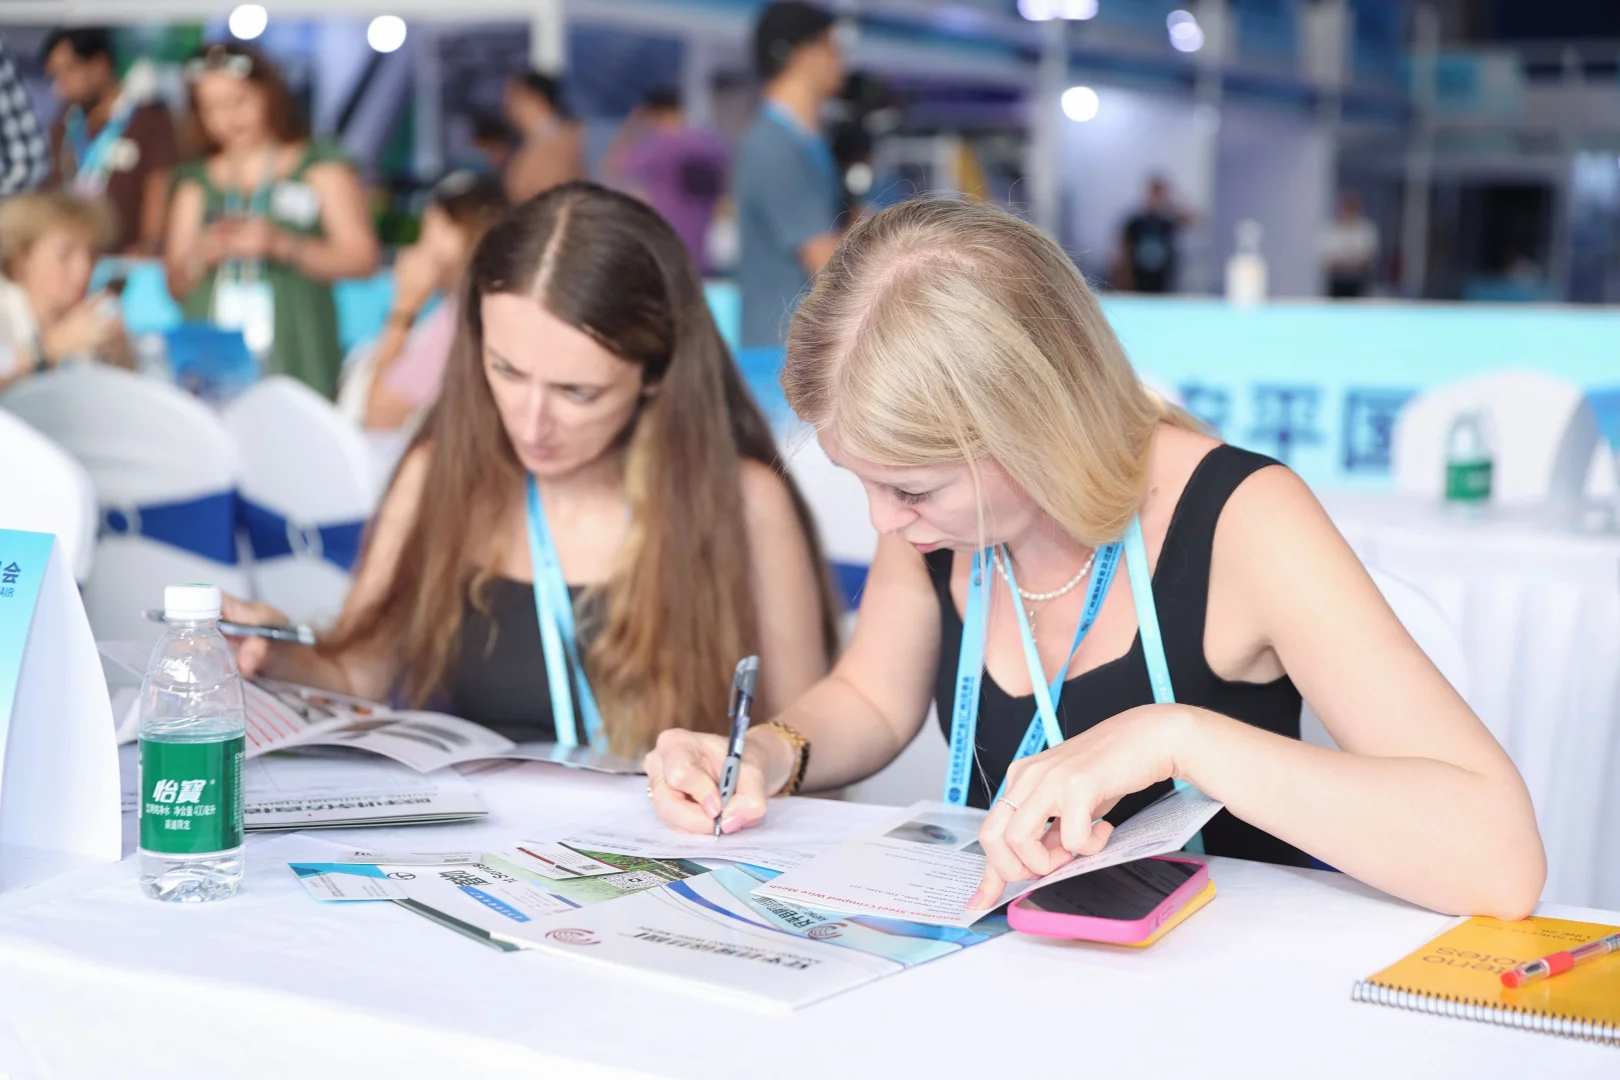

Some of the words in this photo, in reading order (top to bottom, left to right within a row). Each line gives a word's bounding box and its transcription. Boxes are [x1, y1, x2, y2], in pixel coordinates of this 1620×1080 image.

[0, 561, 21, 585] 会
[769, 884, 798, 893] Mesh
[801, 888, 826, 898] Wire
[825, 895, 876, 910] Crimped
[1423, 955, 1504, 975] teno
